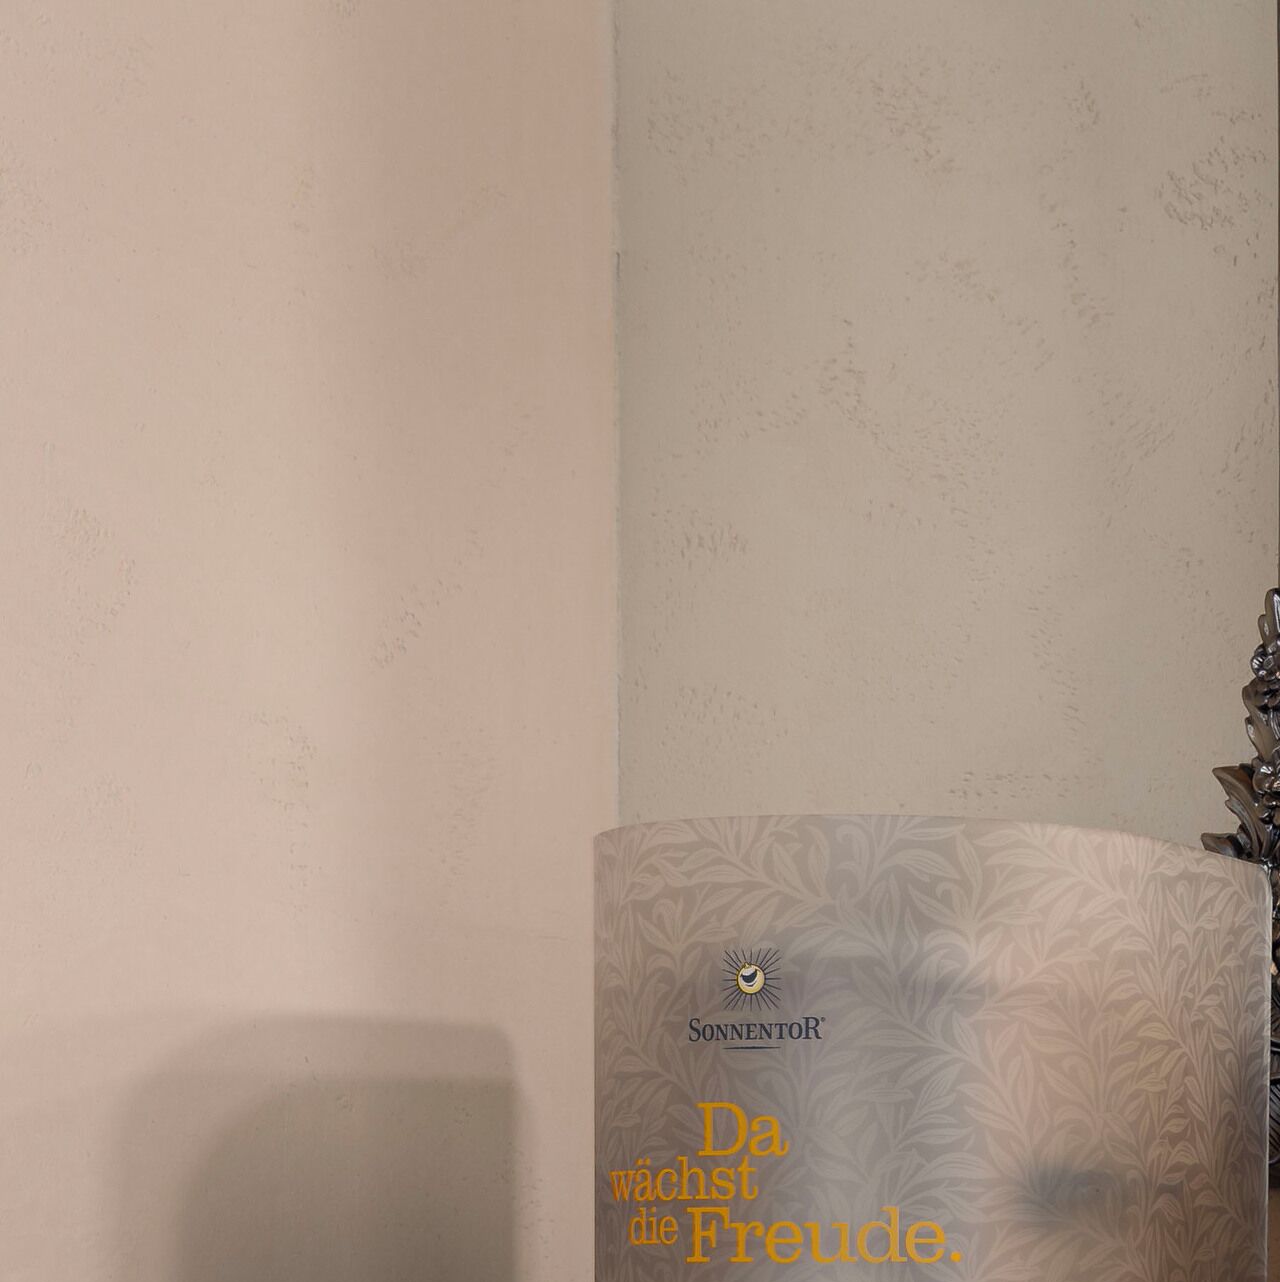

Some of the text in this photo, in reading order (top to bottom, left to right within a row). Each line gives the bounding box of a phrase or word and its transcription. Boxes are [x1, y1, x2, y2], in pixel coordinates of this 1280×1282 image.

[688, 1016, 825, 1041] SONNENTOR
[696, 1101, 790, 1157] Da
[609, 1155, 759, 1201] wächst
[628, 1206, 962, 1264] die Freude.
